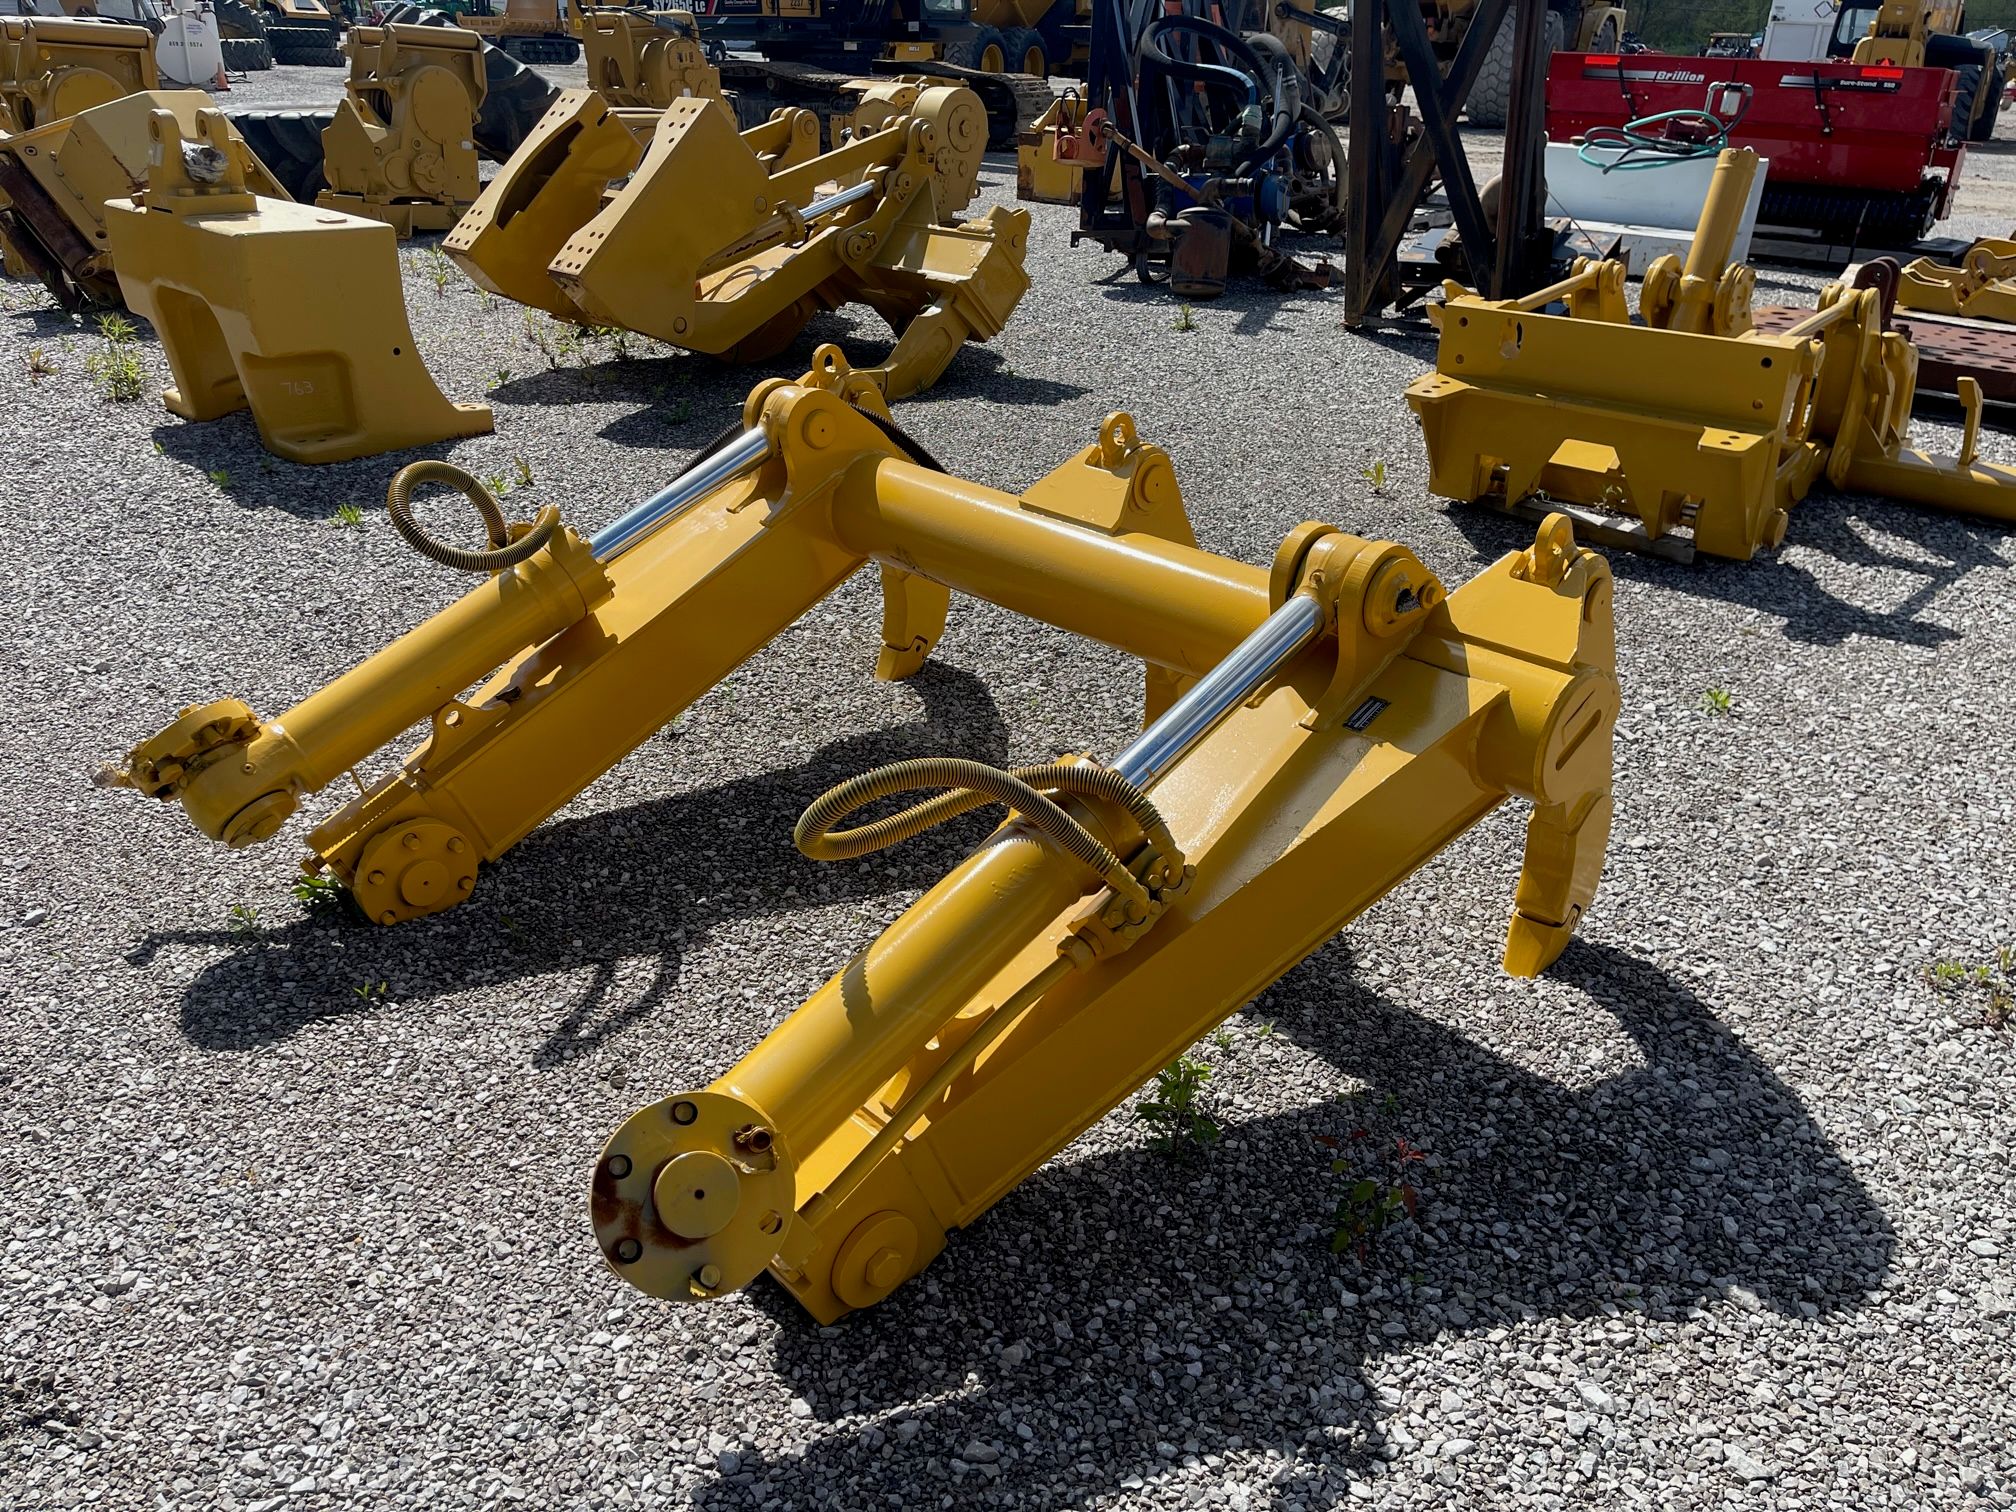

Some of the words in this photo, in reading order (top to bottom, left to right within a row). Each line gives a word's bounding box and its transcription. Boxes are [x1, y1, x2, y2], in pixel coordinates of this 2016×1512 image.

[695, 1, 706, 12] LC
[1656, 71, 1705, 82] Brillion
[280, 380, 314, 396] 763
